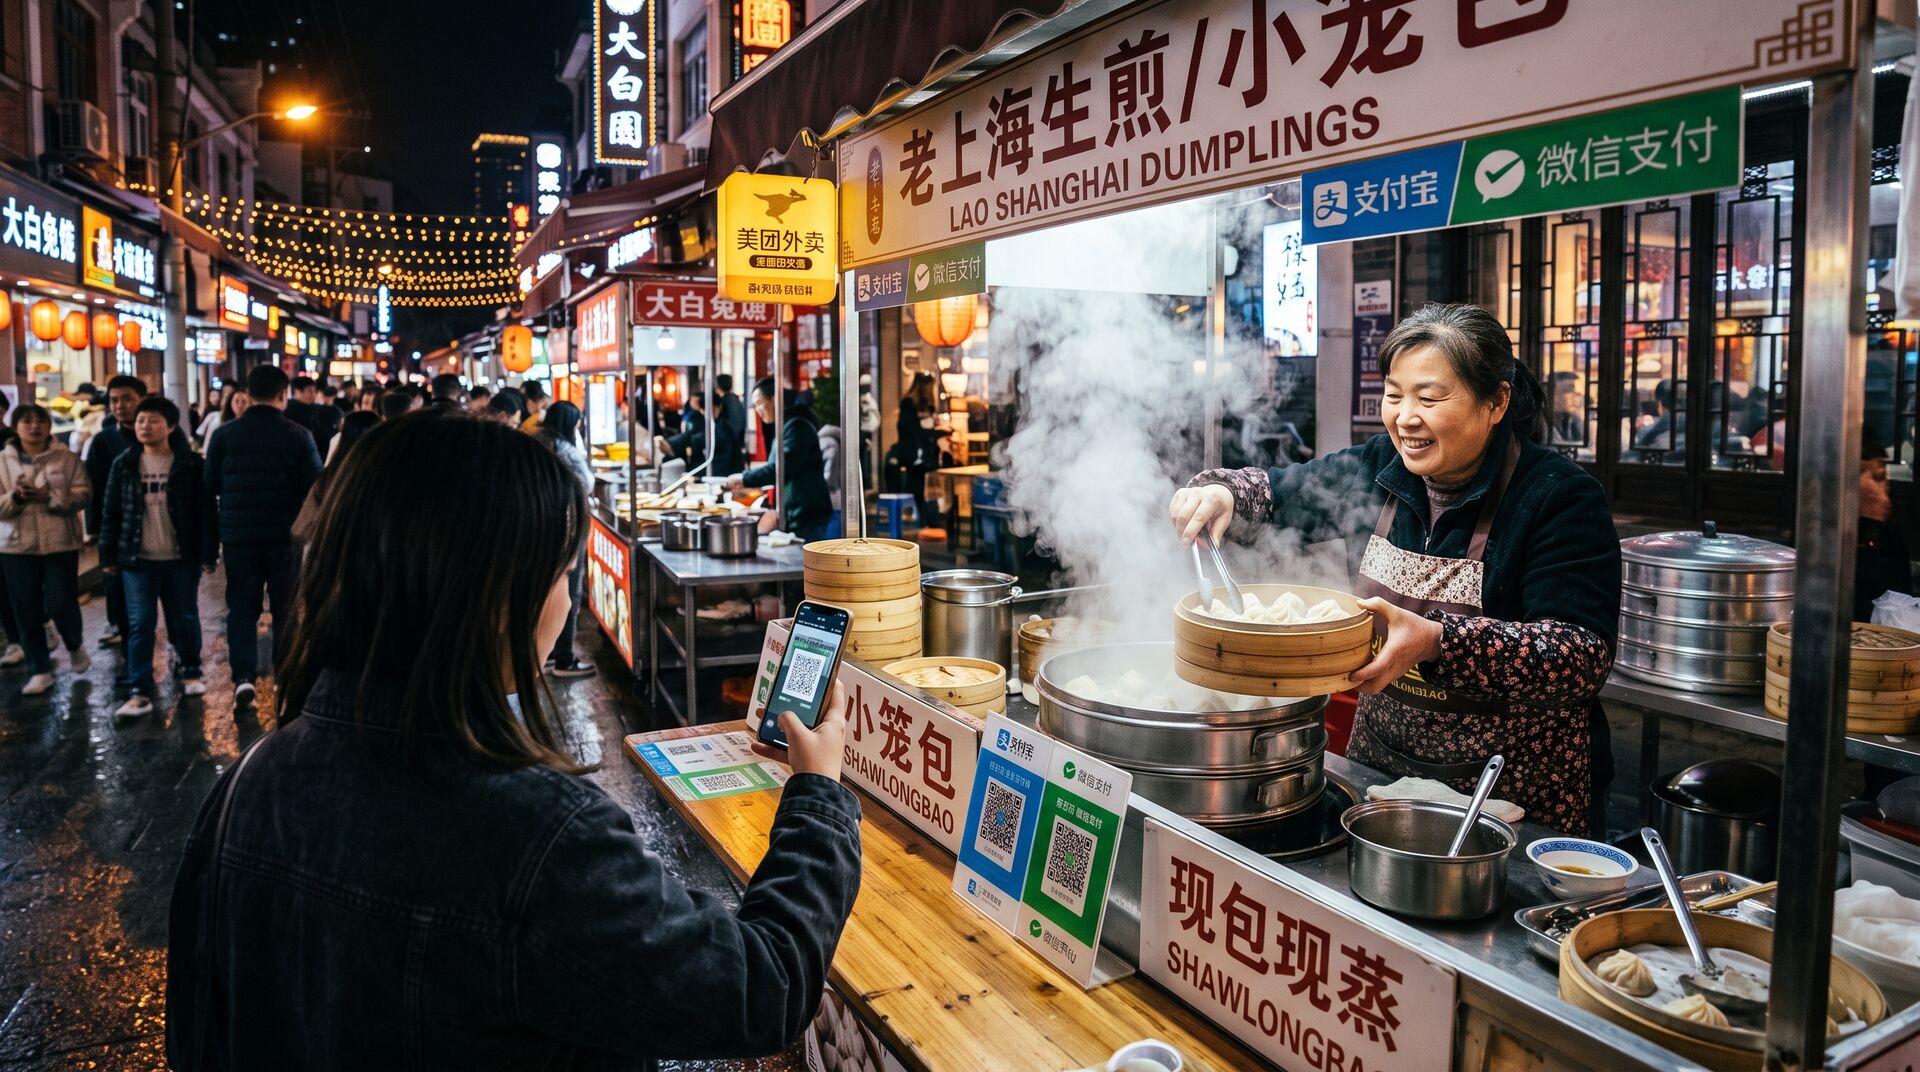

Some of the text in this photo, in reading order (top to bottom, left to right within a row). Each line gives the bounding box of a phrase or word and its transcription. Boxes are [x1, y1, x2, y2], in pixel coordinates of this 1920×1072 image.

[900, 0, 1568, 207] 老上海生煎/小笼
[950, 97, 1380, 232] LAO SHANGHAI DUMPLINGS
[1353, 170, 1439, 217] 支付宝
[1536, 116, 1719, 189] 微信支付
[737, 228, 825, 254] 美团外卖
[933, 255, 981, 286] 微信支付
[872, 271, 902, 297] 支付宝
[844, 684, 956, 800] 小笼包
[1077, 769, 1113, 797] 微信支付
[843, 744, 954, 835] SHAWLONGBAO
[1168, 855, 1404, 1052] 现包现蒸
[1166, 940, 1383, 1072] SHAWLONGB
